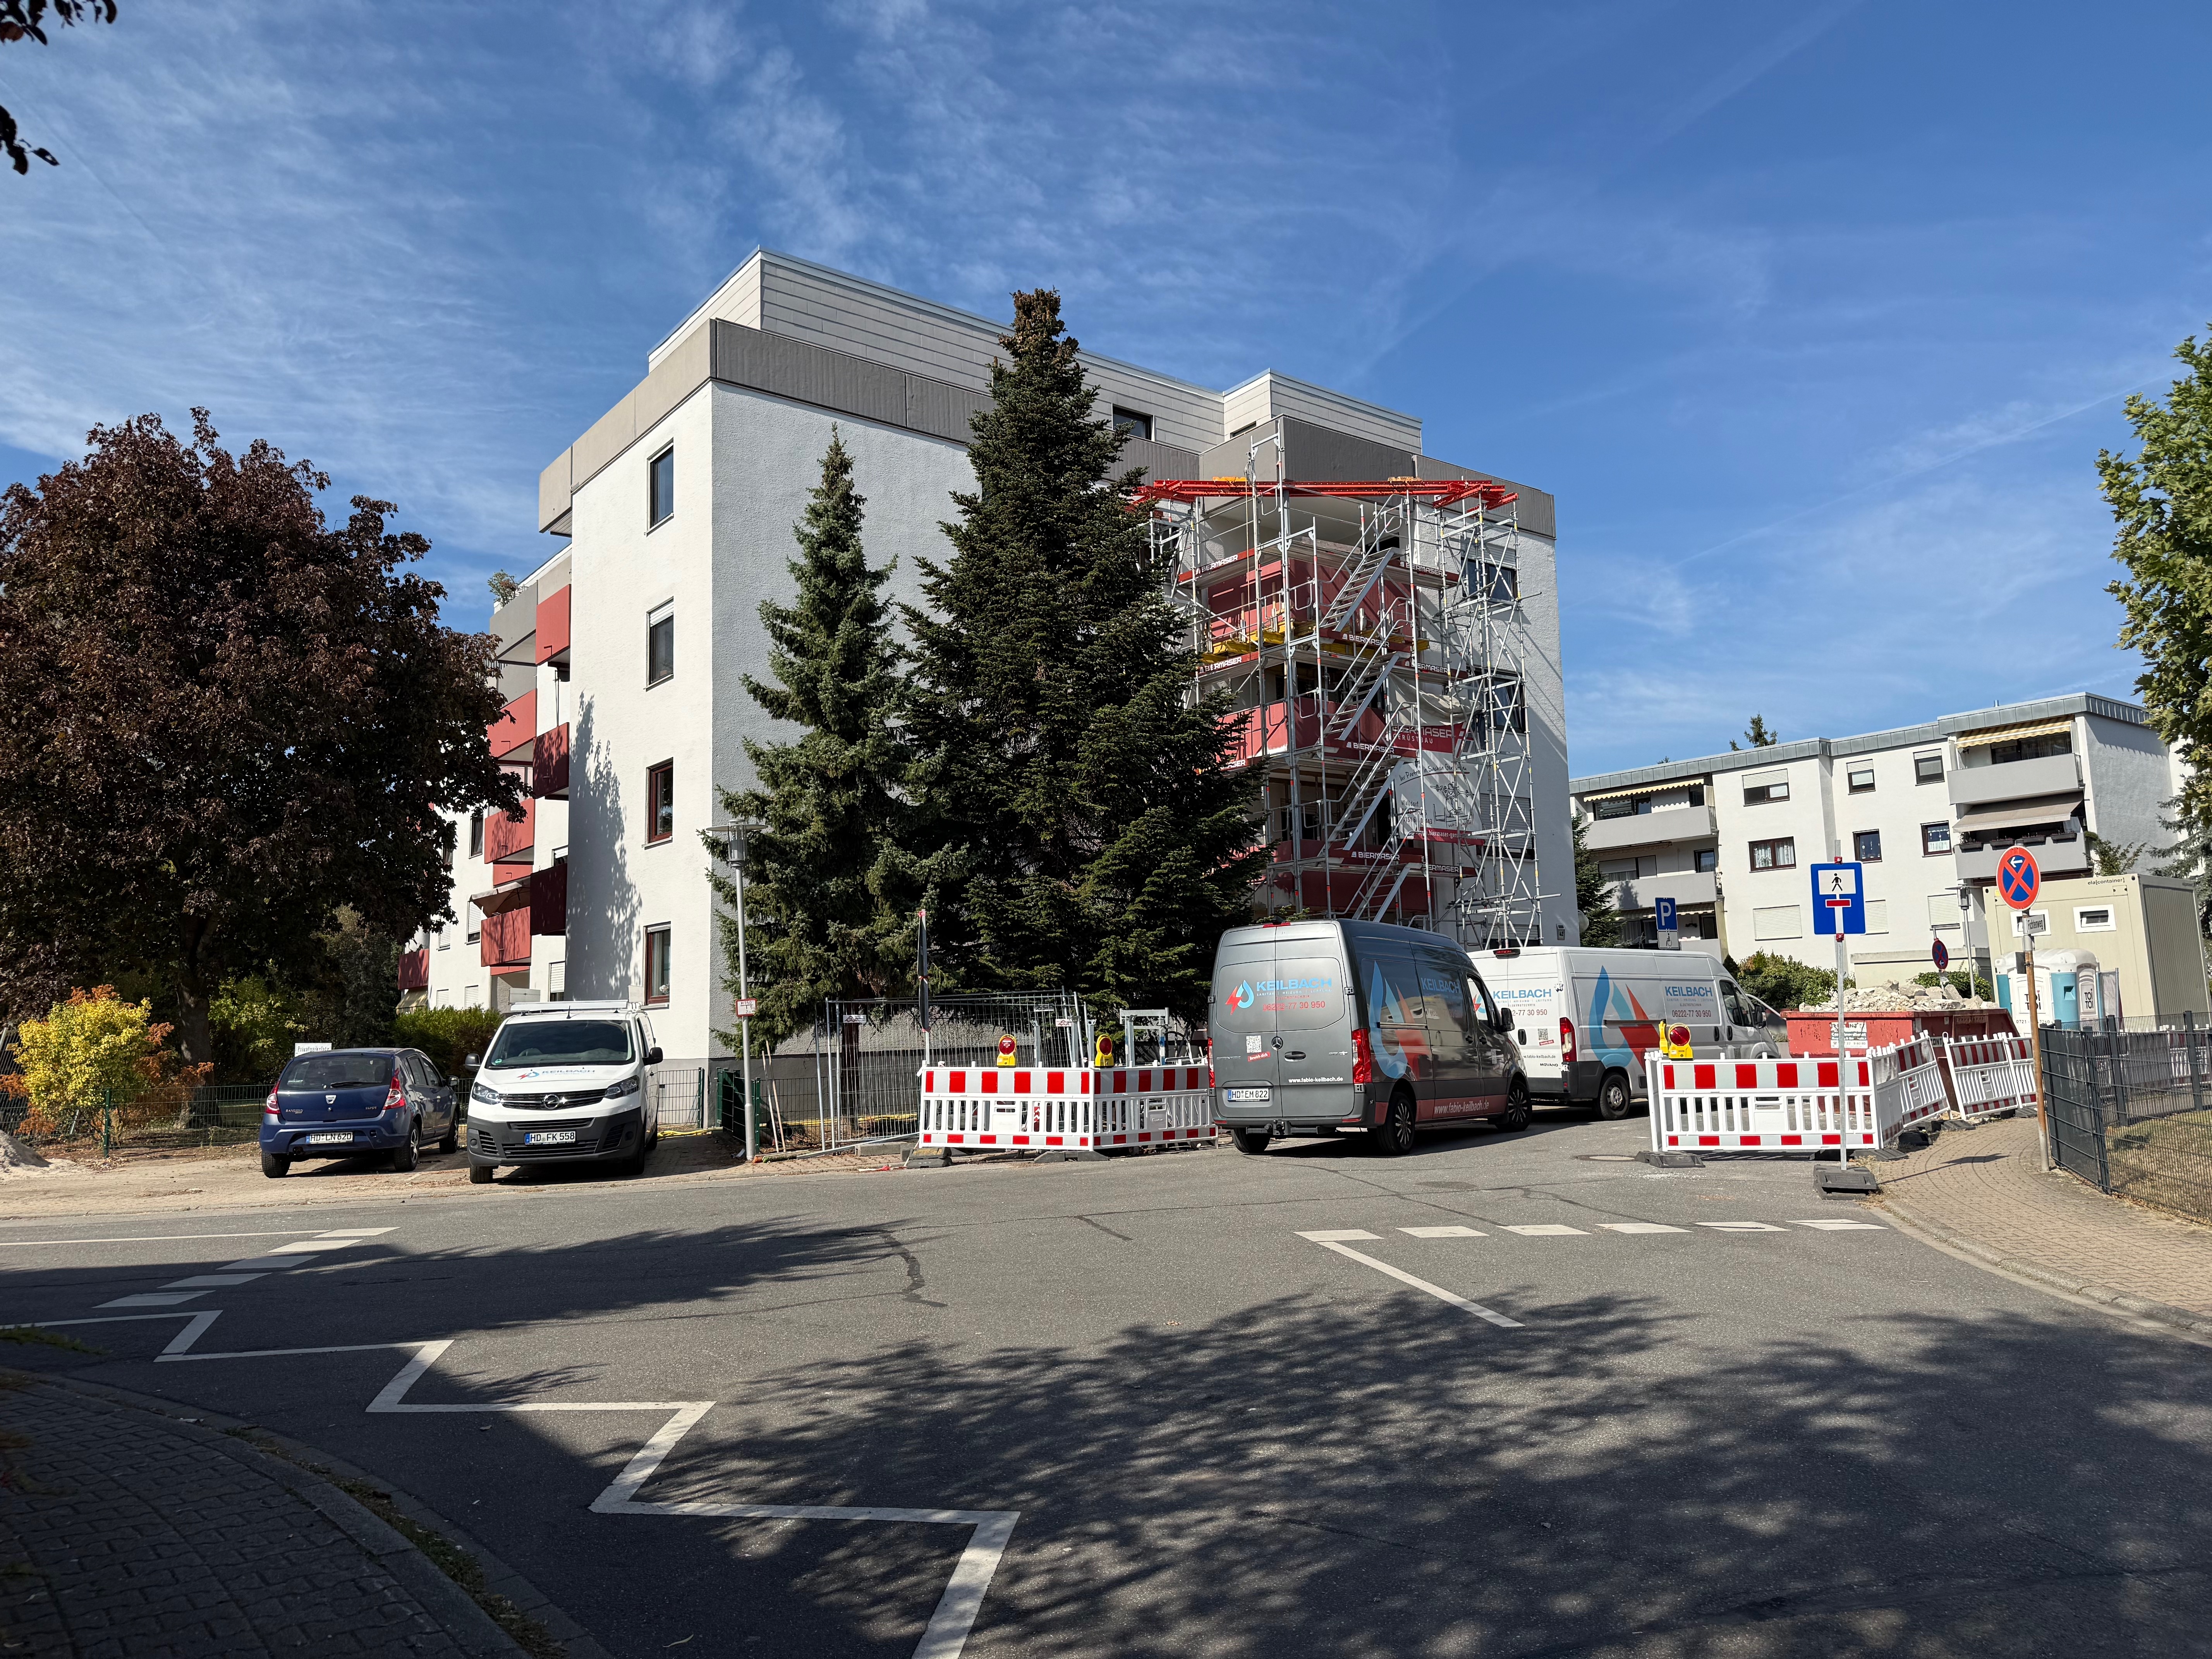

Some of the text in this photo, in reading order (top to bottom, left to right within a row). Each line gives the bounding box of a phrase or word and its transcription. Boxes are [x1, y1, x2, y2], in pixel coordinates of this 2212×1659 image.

[1202, 554, 1238, 573] BIERMASER
[1406, 562, 1443, 576] BERMASER
[1406, 769, 1421, 779] Partne
[1660, 902, 1671, 926] P
[2028, 919, 2043, 930] Fichtenweg
[1257, 977, 1332, 991] KEILBACH
[1421, 977, 1461, 994] KEILBACH
[1493, 989, 1551, 999] KEILBACH
[1665, 986, 1712, 997] KEILBACH
[2084, 990, 2093, 1000] TOI
[2085, 1000, 2094, 1009] TOI
[1434, 1099, 1489, 1114] www.fabio-keilbach.de
